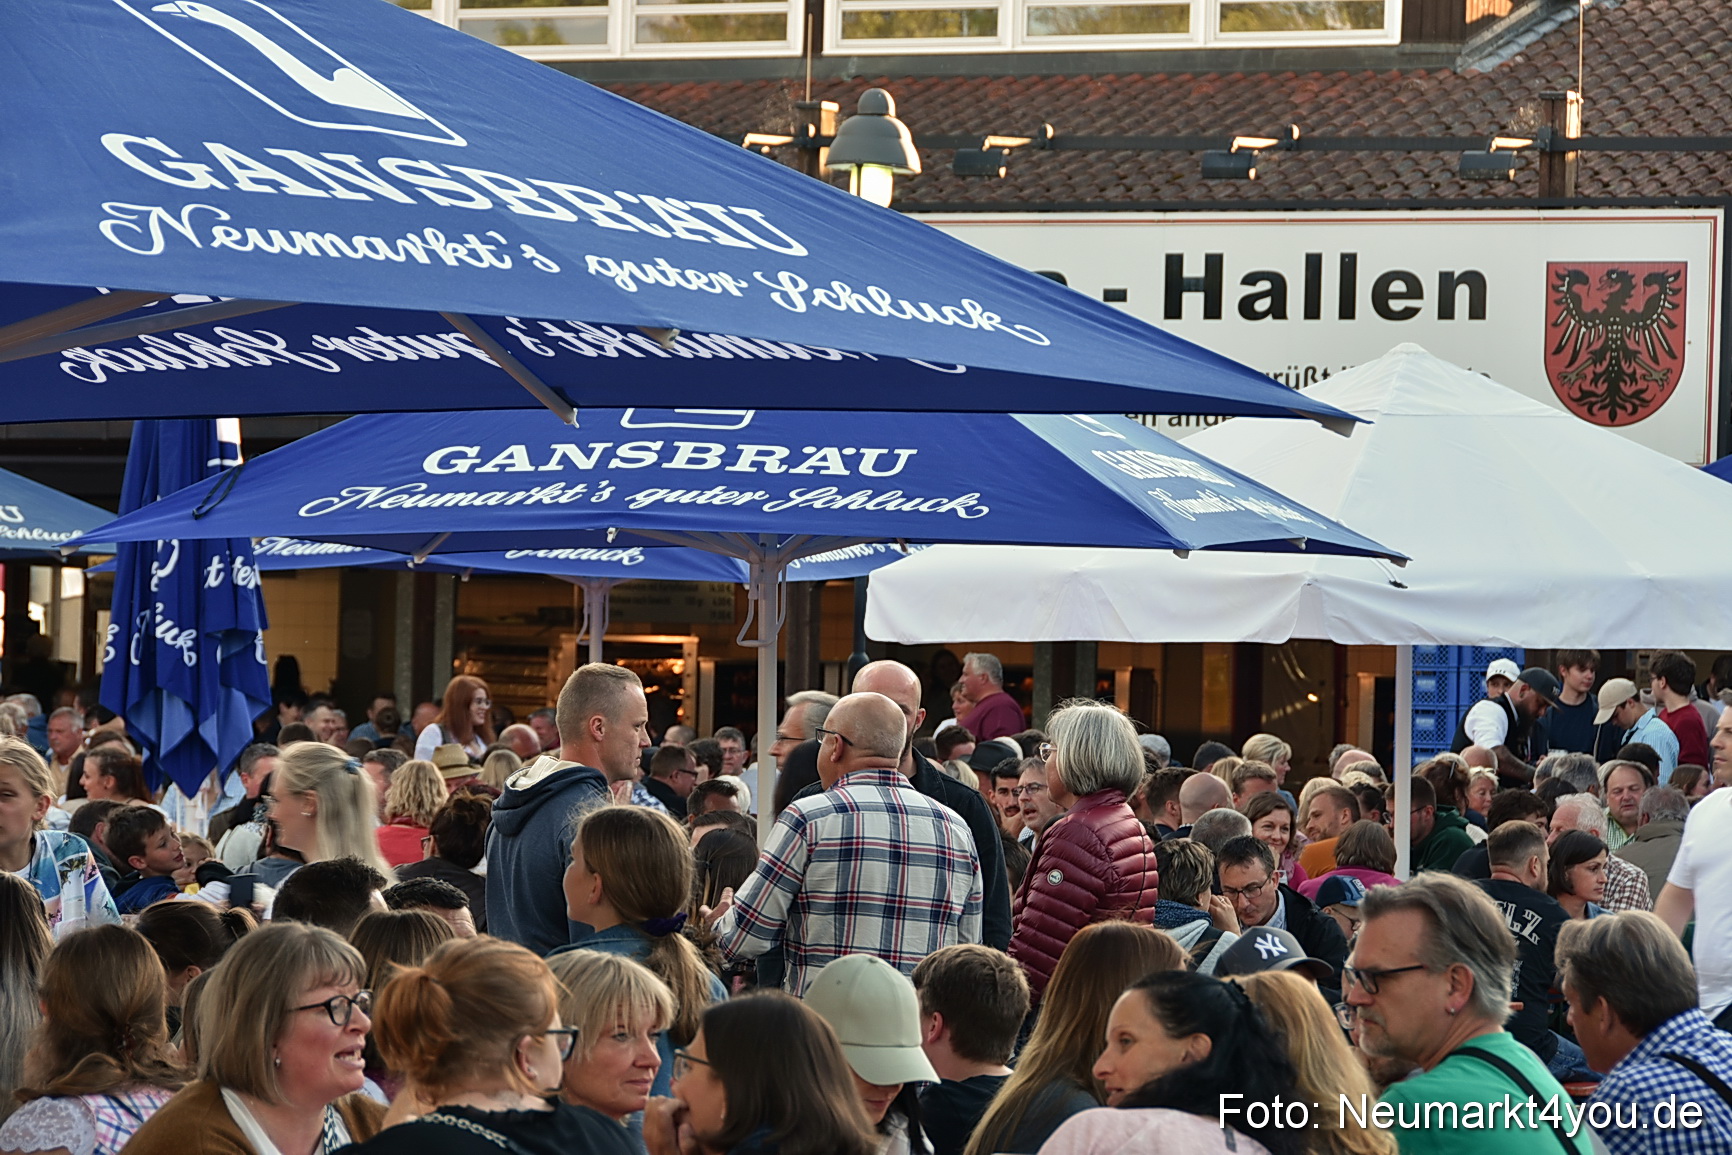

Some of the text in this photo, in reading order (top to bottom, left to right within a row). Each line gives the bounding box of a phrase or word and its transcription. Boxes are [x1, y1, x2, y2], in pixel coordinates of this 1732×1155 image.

[99, 131, 809, 258] GANSBRÄU
[98, 202, 1051, 347] Neumarkt's guter Schluck
[1164, 253, 1487, 321] Hallen
[422, 442, 918, 478] GANSBRÄU
[297, 480, 991, 520] Neumarkt's guter Schluck
[1254, 932, 1289, 960] NY
